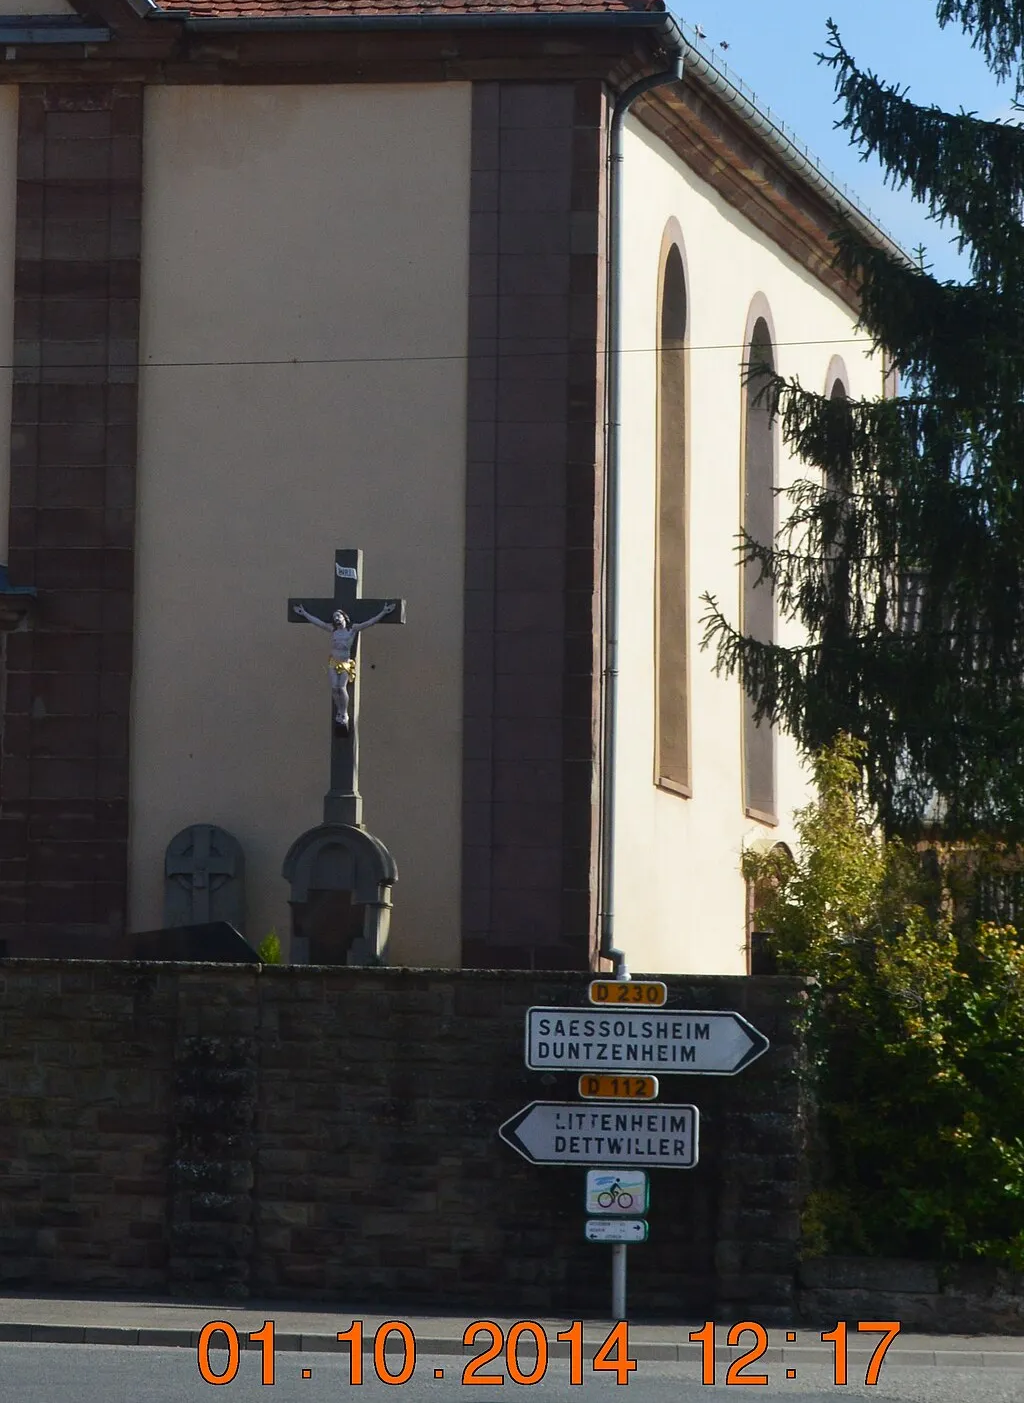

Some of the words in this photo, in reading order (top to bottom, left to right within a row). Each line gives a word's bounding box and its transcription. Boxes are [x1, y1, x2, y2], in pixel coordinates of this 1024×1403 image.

[597, 984, 608, 1000] D
[617, 985, 658, 1002] 230
[538, 1019, 711, 1040] SAESSOLSHEIM
[538, 1042, 697, 1063] DUNTZENHEIM
[588, 1078, 599, 1094] D
[611, 1079, 647, 1095] 112
[555, 1136, 685, 1156] DETTWILLER
